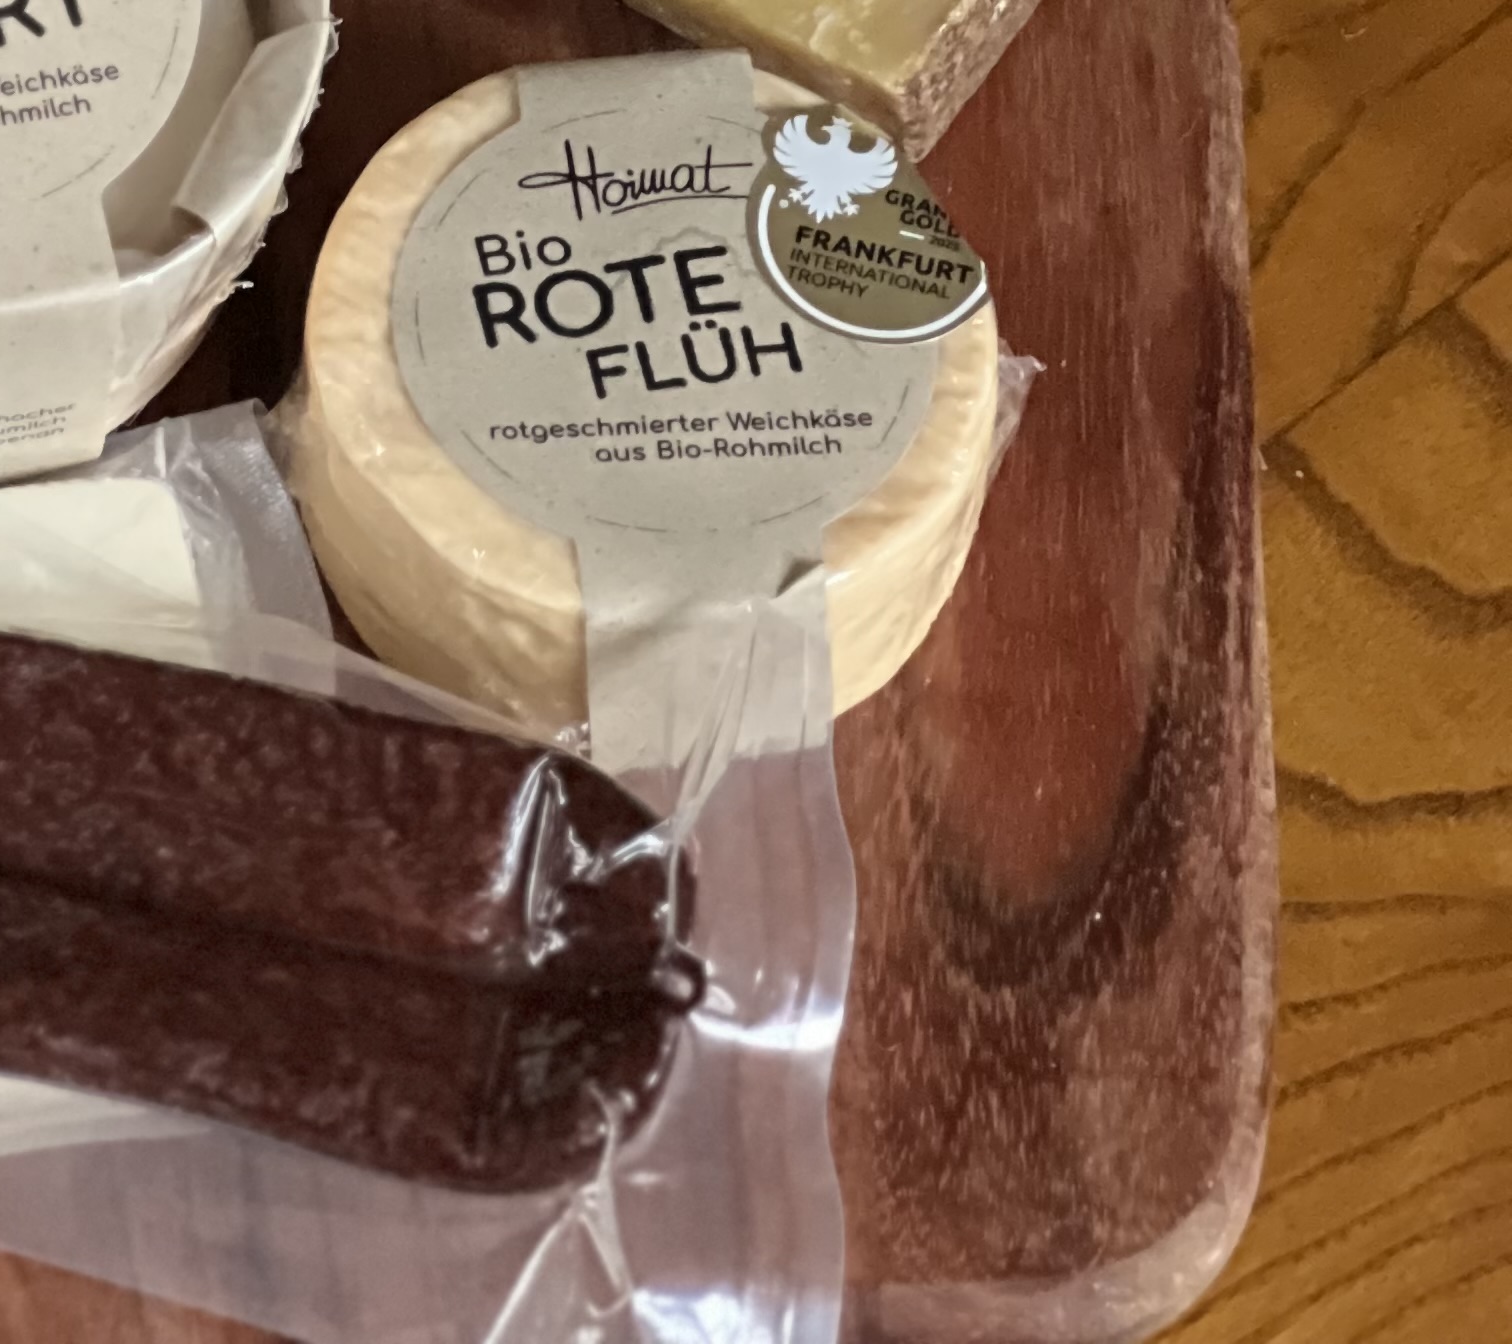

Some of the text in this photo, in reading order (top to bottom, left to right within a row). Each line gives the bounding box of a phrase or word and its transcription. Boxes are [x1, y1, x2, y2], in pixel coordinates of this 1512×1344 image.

[474, 229, 572, 277] Bio
[790, 248, 951, 300] INTERNATIONAL
[795, 225, 975, 284] FRANKFURT
[472, 245, 742, 349] ROTE
[788, 265, 870, 298] TROPHY
[585, 319, 804, 400] FLÜH
[489, 408, 874, 445] rotgeschmierter Weichkäse
[594, 434, 842, 463] aus Bio-Rohmilch
